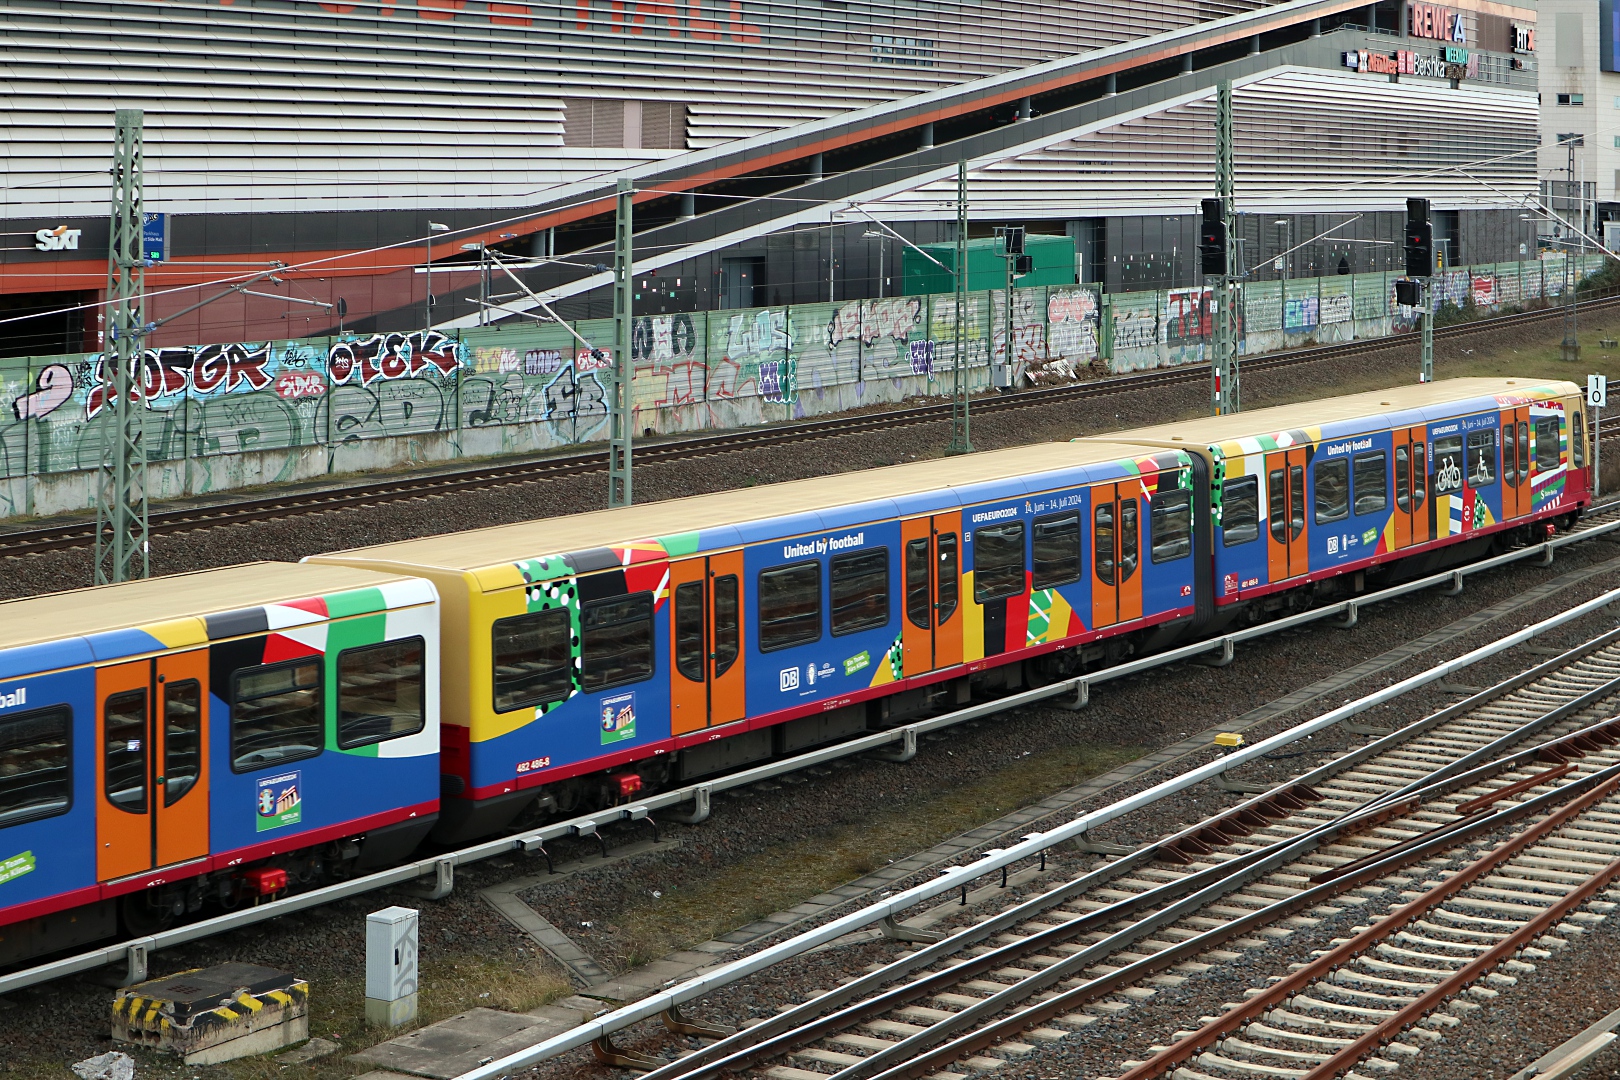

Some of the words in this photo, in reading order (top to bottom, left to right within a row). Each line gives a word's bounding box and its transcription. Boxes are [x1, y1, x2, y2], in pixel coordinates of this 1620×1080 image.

[1413, 4, 1451, 40] REWE
[1367, 53, 1397, 74] Müller
[1445, 47, 1468, 64] WEEKDAY
[1414, 53, 1445, 78] Bershka
[1594, 377, 1599, 389] 1
[1592, 391, 1601, 402] 0
[1327, 443, 1345, 455] United
[1345, 441, 1352, 454] by
[1352, 438, 1372, 450] football
[1025, 501, 1033, 513] 14.
[1033, 502, 1044, 514] Juni
[1050, 500, 1058, 509] 14.
[1058, 498, 1067, 509] Juli
[1068, 495, 1082, 506] 2024
[784, 541, 815, 558] United
[816, 540, 827, 555] by
[829, 532, 864, 550] football
[783, 671, 797, 688] DB
[0, 687, 26, 708] ball
[517, 762, 529, 772] 482
